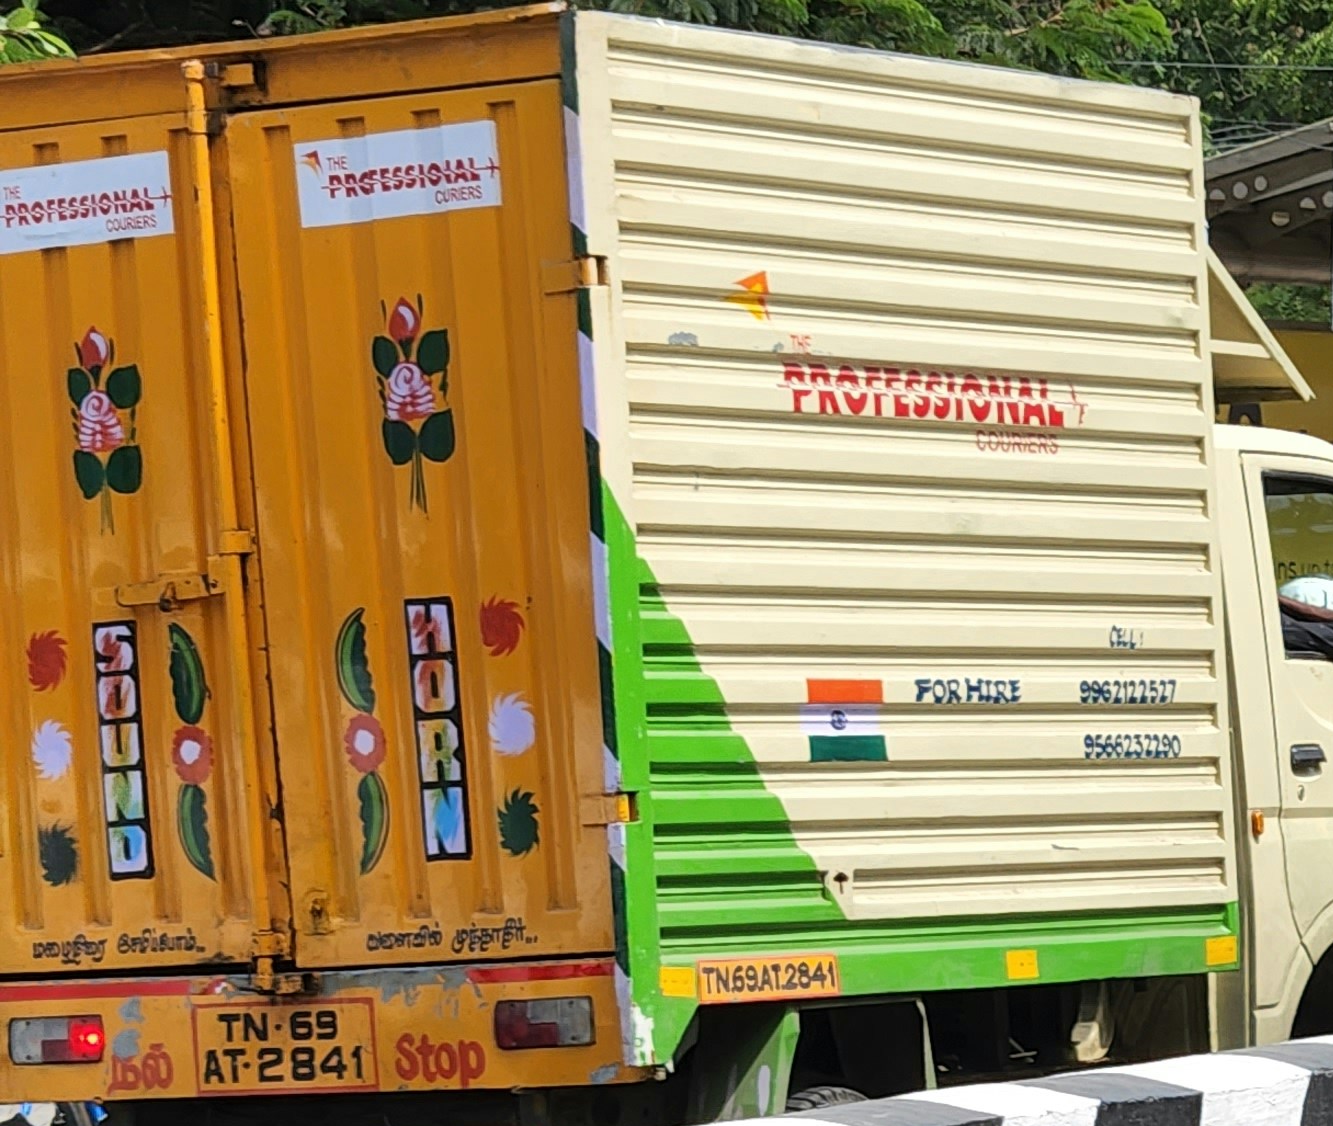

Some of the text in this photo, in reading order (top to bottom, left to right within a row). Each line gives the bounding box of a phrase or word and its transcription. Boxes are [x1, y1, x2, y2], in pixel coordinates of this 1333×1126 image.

[325, 155, 348, 171] THE
[3, 186, 21, 200] THE
[4, 187, 155, 229] PROFESSIONAL
[105, 214, 157, 233] COURIERS
[790, 334, 812, 354] THE
[783, 361, 1064, 428] PROFESSIONAL
[976, 429, 1060, 455] COURIERS
[914, 677, 1022, 704] FOR HIRE
[404, 600, 468, 857] HORN
[94, 624, 152, 877] SOUND
[394, 1032, 486, 1088] Stop
